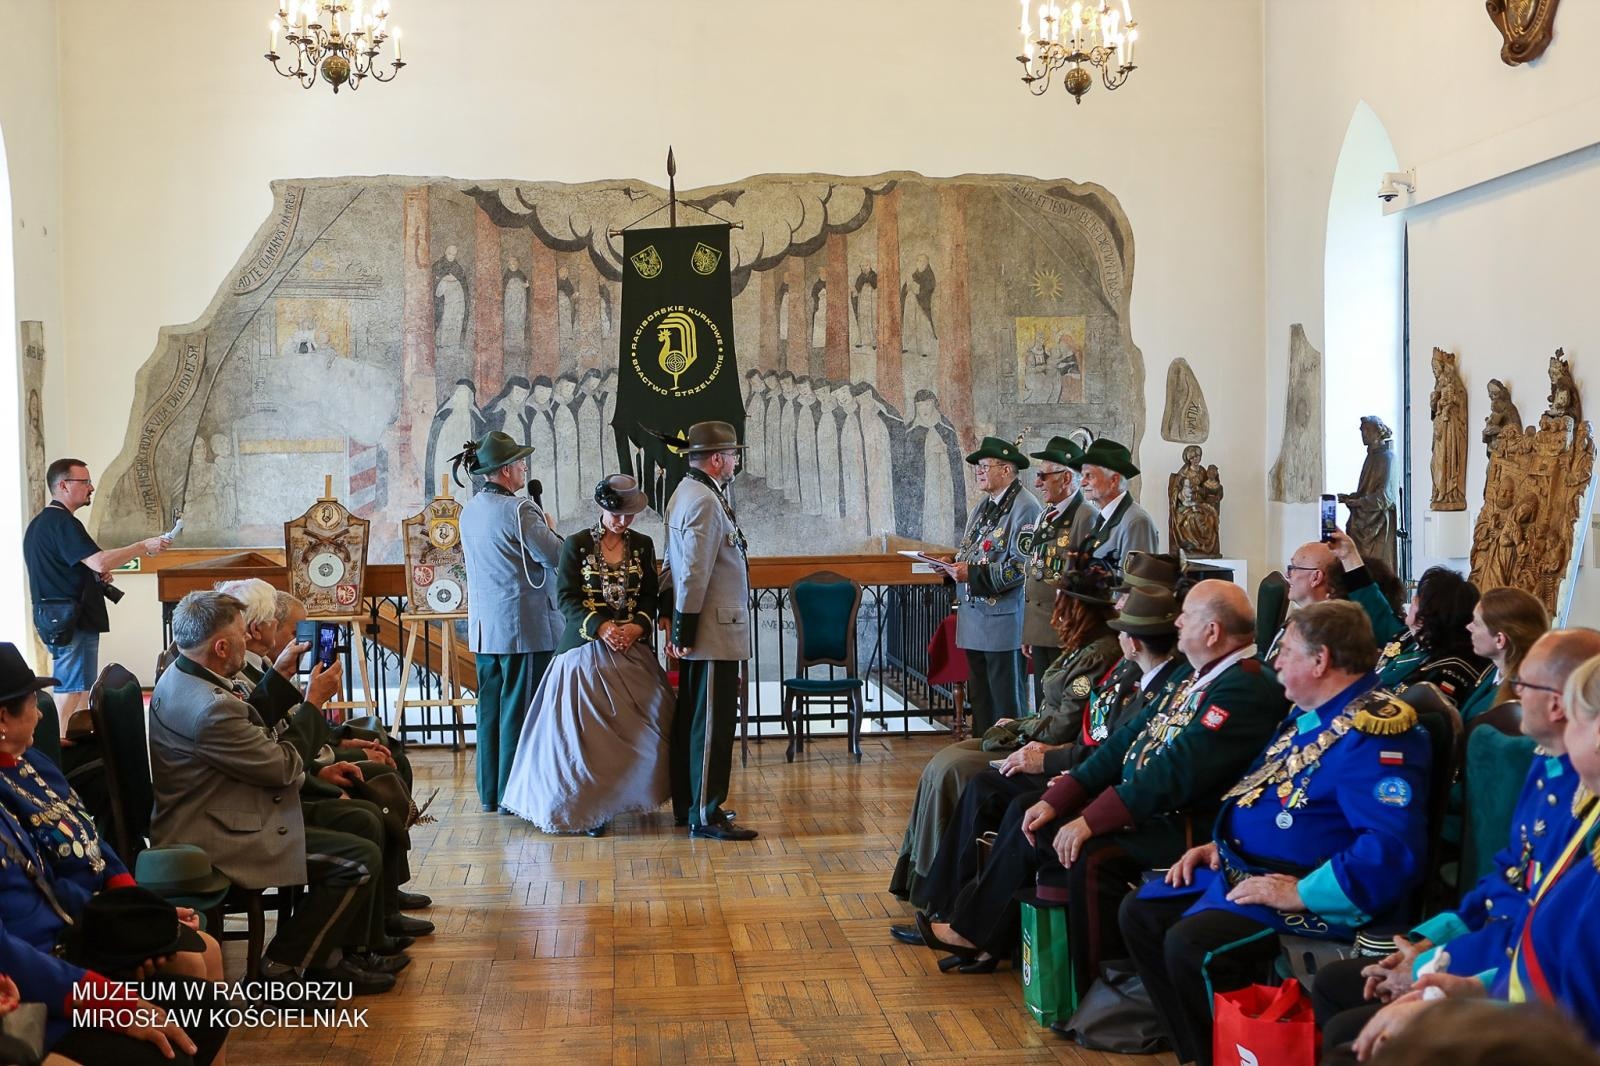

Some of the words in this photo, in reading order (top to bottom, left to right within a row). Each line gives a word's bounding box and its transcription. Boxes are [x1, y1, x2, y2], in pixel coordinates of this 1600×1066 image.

[238, 274, 251, 288] AD
[247, 266, 263, 281] TE
[632, 305, 685, 350] RACIBORSKIE
[687, 307, 724, 345] KURKOWE
[632, 358, 668, 396] BRACTWO
[674, 354, 724, 397] STRZELECKIE
